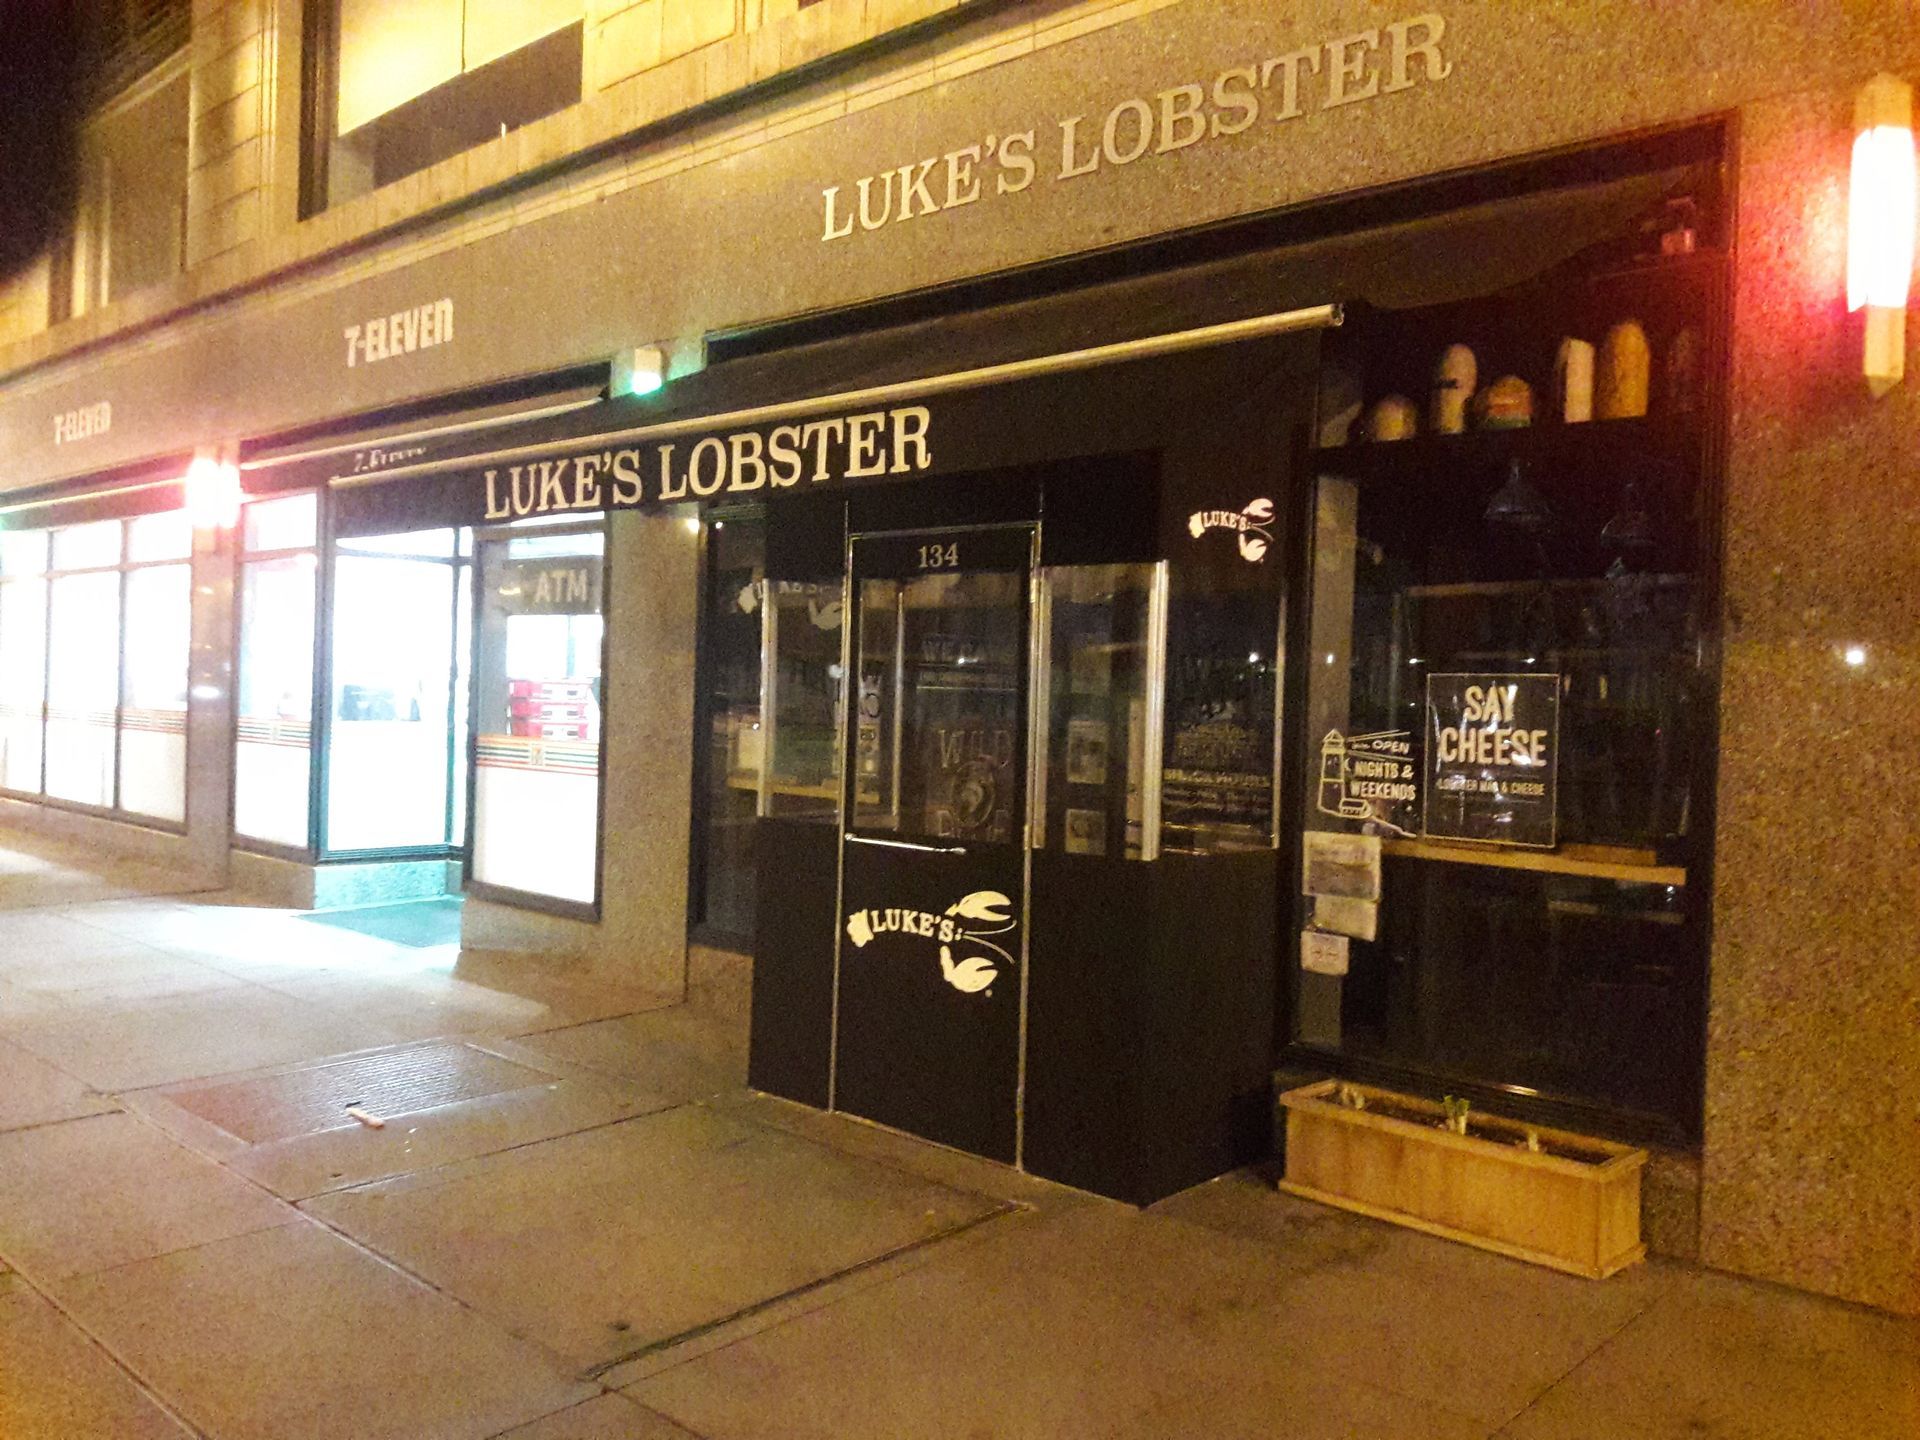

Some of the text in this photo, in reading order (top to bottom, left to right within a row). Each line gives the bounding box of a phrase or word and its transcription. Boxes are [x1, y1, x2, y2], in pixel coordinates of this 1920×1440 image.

[822, 12, 1453, 242] LUKE'S LOBSTER
[484, 405, 933, 521] LUKE'S LOBSTER
[1202, 510, 1248, 532] LUKE'S
[918, 542, 959, 568] 134
[534, 569, 588, 604] ATM
[1464, 684, 1518, 722] SAY
[1371, 739, 1410, 754] OPEN
[1439, 727, 1548, 766] CHEESE
[1354, 761, 1414, 780] NIGHTS &
[1436, 778, 1478, 791] LOER
[1350, 781, 1417, 801] WEEKENDS
[870, 908, 955, 943] LUKE'S
